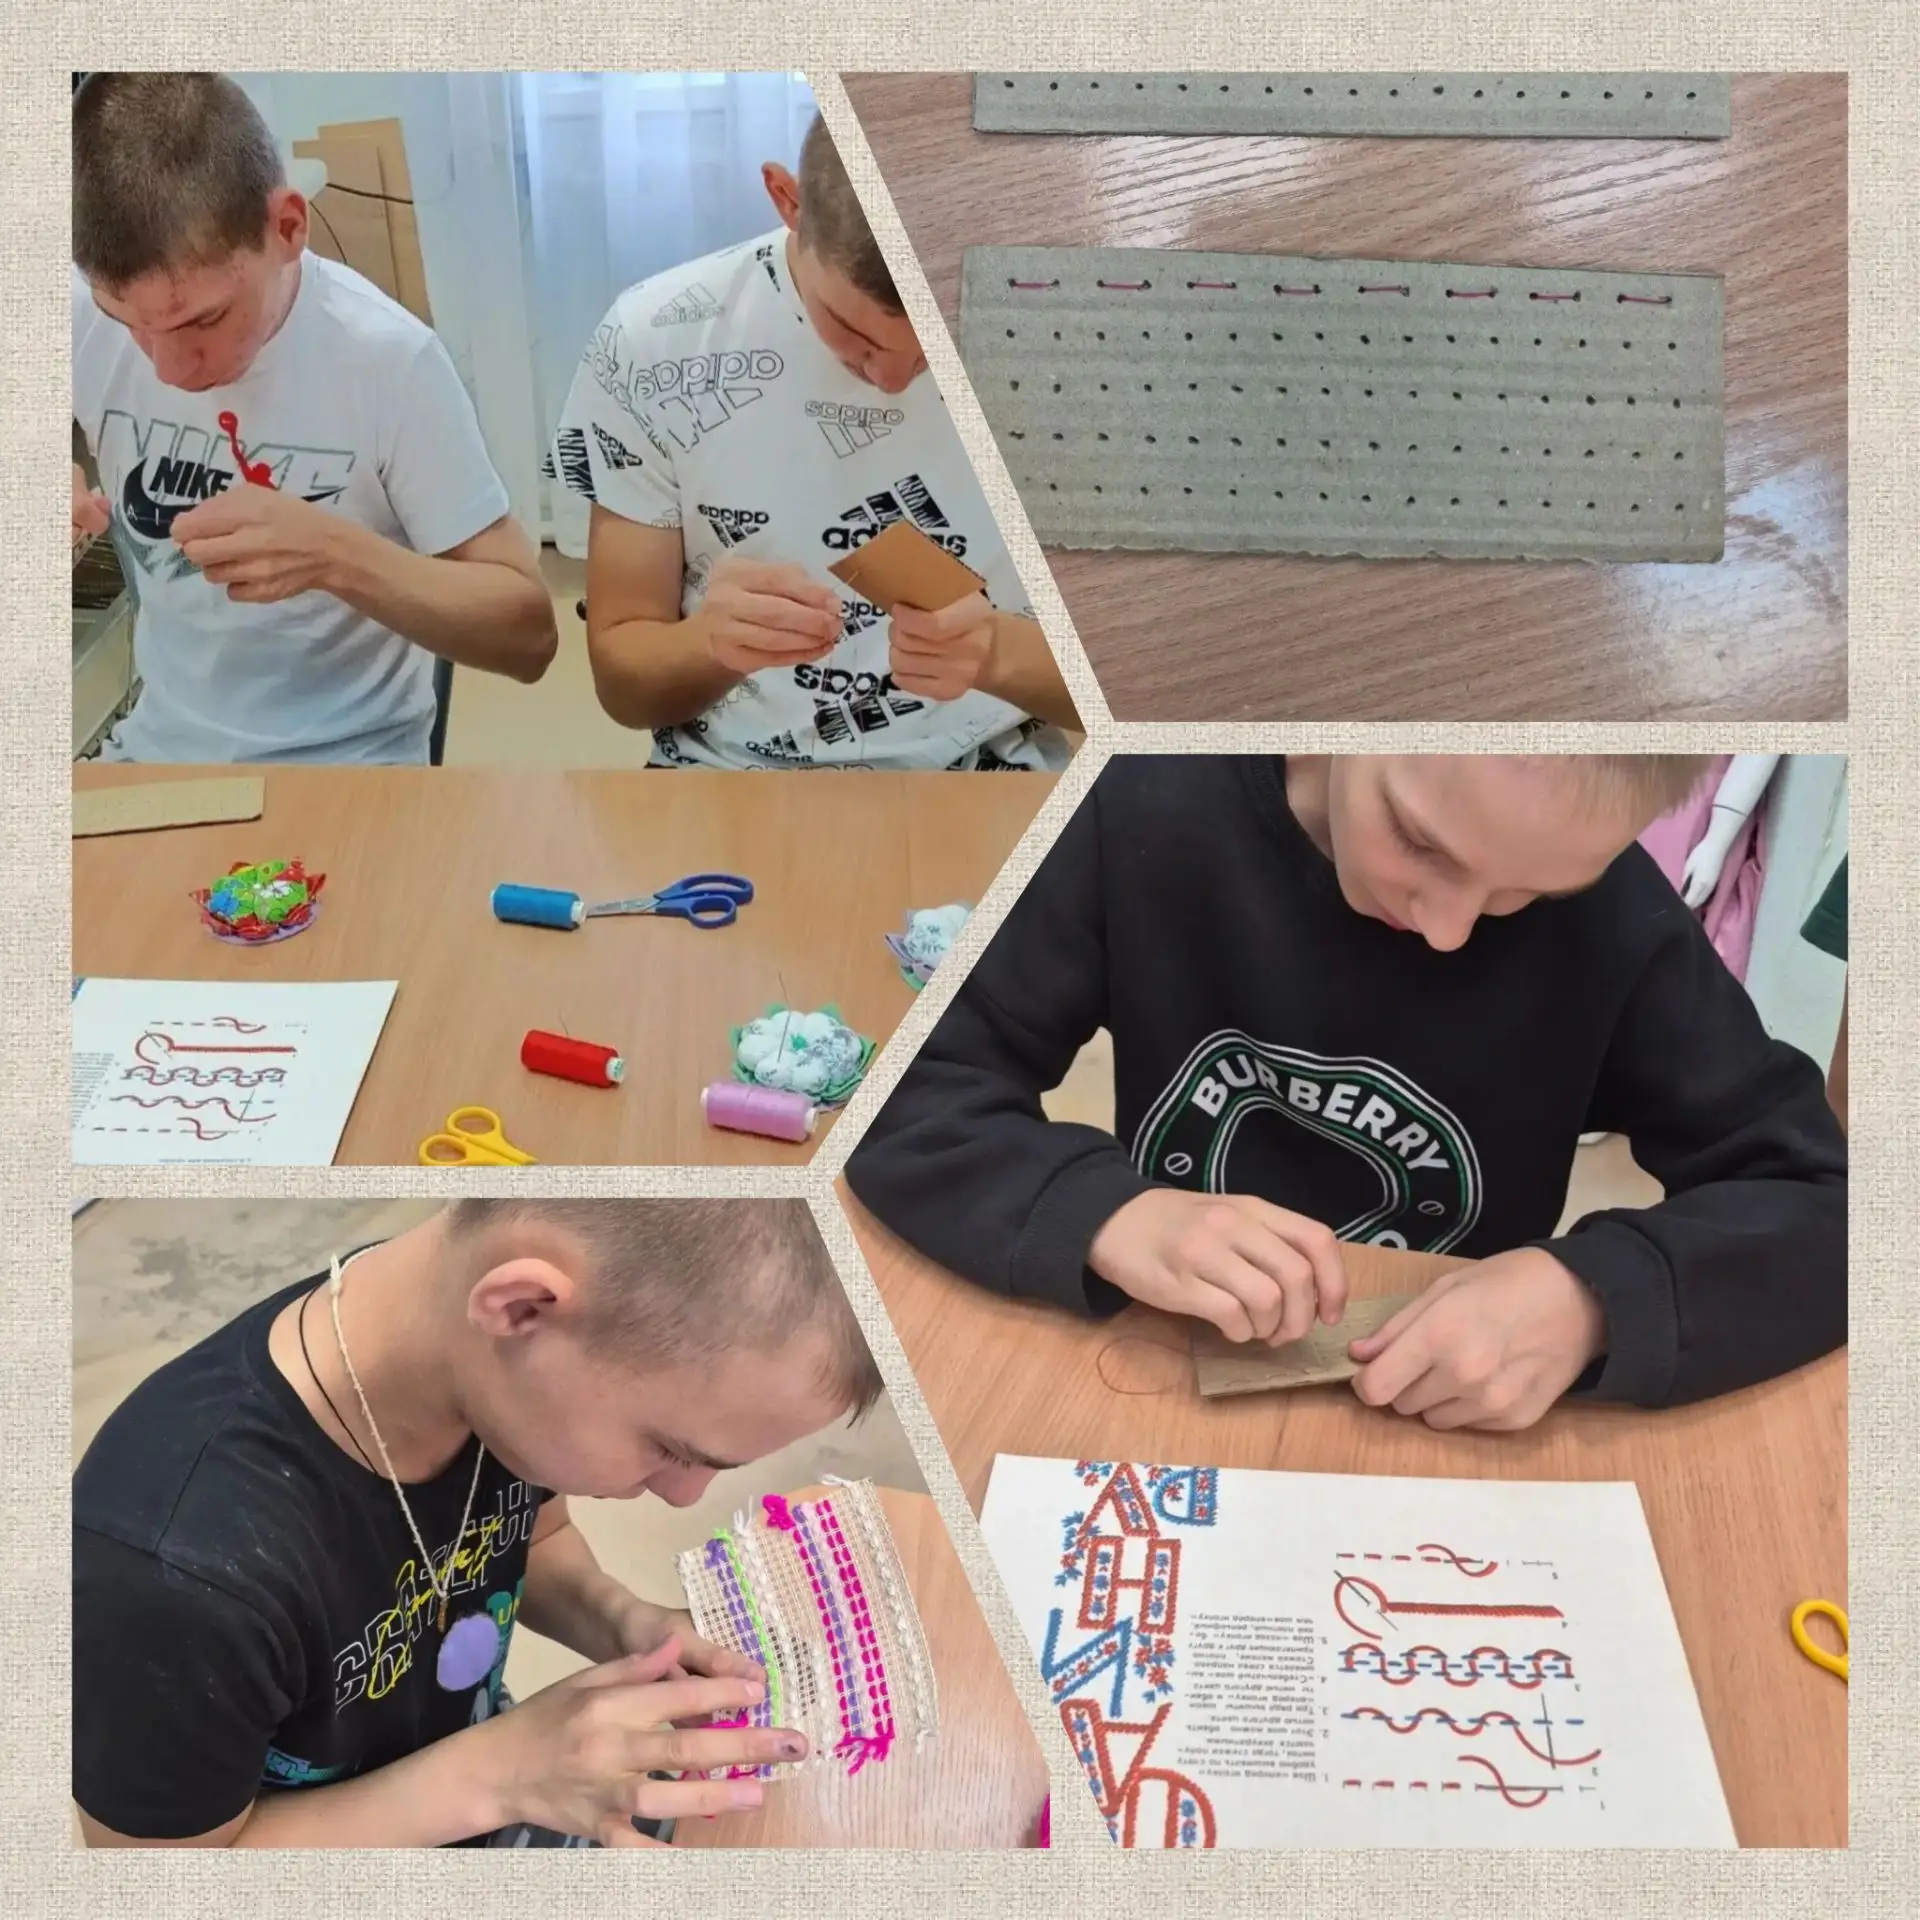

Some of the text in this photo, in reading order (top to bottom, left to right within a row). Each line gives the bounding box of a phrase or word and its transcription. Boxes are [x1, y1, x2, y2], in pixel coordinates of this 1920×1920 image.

[634, 349, 784, 400] adidas
[804, 400, 905, 427] adidas
[149, 456, 235, 501] NIKE
[698, 504, 770, 526] adidas
[822, 523, 967, 558] adas
[1190, 1054, 1450, 1171] BURBERRY
